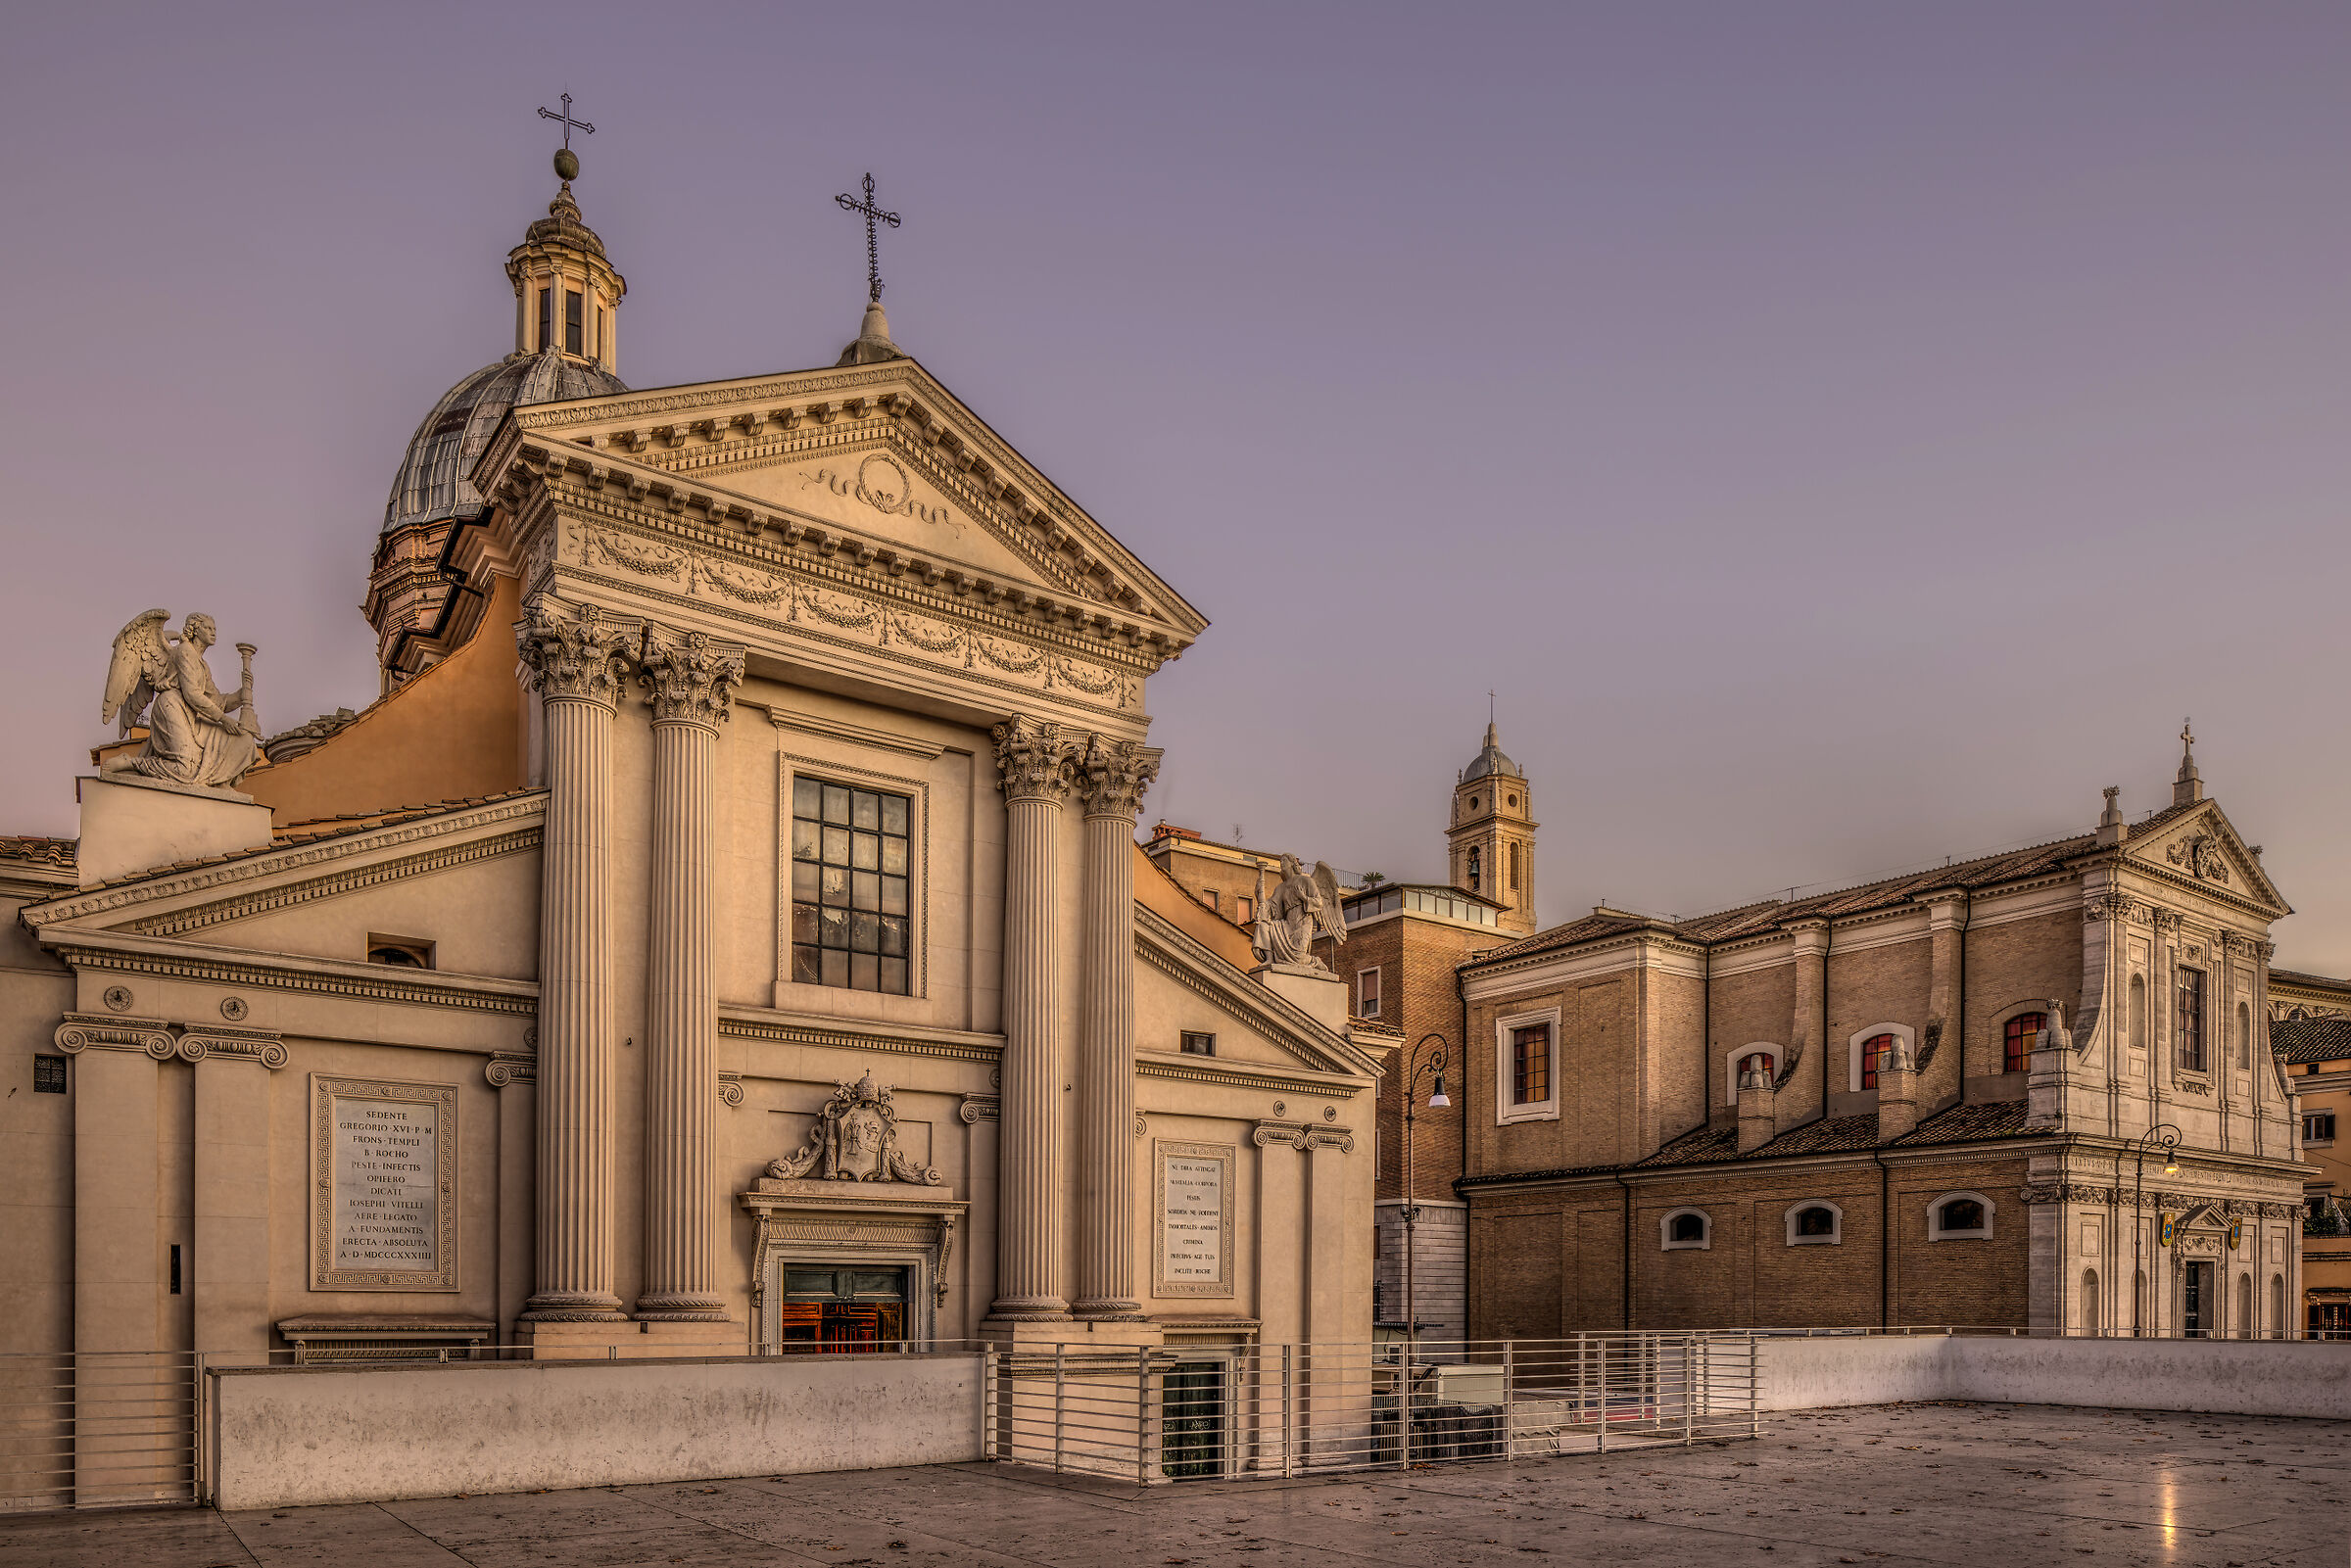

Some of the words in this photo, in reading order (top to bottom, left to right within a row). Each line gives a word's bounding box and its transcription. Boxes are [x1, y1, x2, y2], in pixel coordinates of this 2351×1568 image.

[366, 1111, 408, 1120] SEDENTE
[340, 1122, 388, 1132] GREGORIO
[388, 1137, 420, 1146] TEMPLI
[376, 1150, 408, 1159] ROCHO
[352, 1162, 377, 1170] PESTE
[382, 1163, 421, 1171] INFECTIS
[370, 1187, 402, 1196] DICATI
[391, 1200, 423, 1209] VITELLI
[360, 1225, 423, 1234] FUNDAMENTIS
